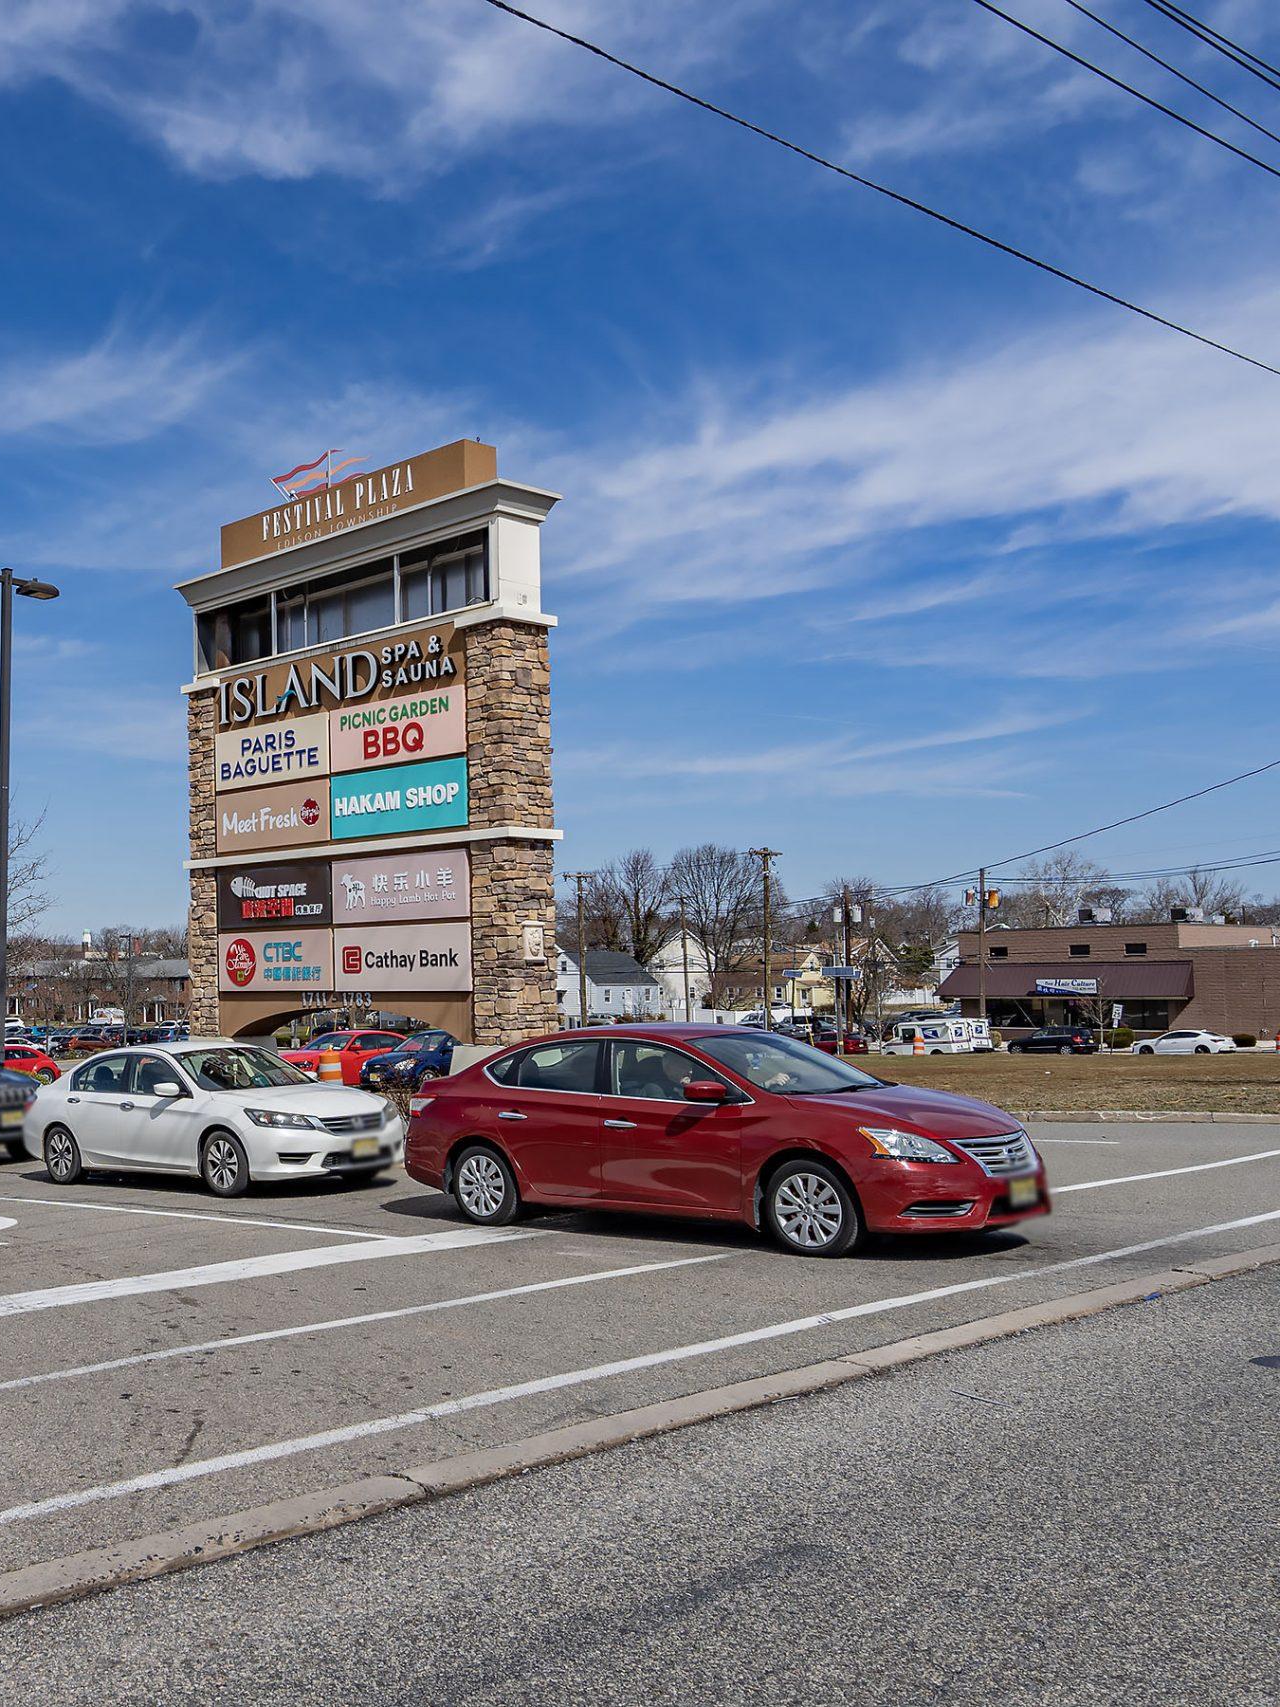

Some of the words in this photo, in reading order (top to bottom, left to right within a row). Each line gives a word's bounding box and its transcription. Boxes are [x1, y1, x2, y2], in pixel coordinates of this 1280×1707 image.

[262, 489, 344, 541] FESTIVAL
[355, 464, 414, 510] PLAZA
[277, 529, 322, 550] EDISON
[381, 640, 420, 664] SPA
[428, 635, 441, 653] &
[381, 656, 454, 688] SAUNA
[219, 650, 379, 725] ISLAND
[340, 706, 386, 731] PICNIC
[389, 696, 450, 722] GARDEN
[241, 730, 296, 756] PARIS
[363, 721, 425, 760] BBQ
[221, 747, 319, 781] BAGUETTE
[334, 791, 401, 817] HAKAM
[405, 782, 460, 808] SHOP
[222, 813, 258, 836] Meet
[260, 806, 299, 831] Fresh
[277, 883, 307, 897] SPACE
[372, 867, 454, 893] 快乐小羊
[370, 896, 397, 908] Happy
[399, 893, 421, 904] Lamb
[424, 891, 439, 902] Hot
[441, 889, 457, 901] Pot
[263, 941, 303, 963] CTBC
[364, 949, 416, 972] Cathay
[419, 948, 459, 968] Bank
[301, 992, 327, 1008] 1711
[342, 991, 372, 1008] 1783
